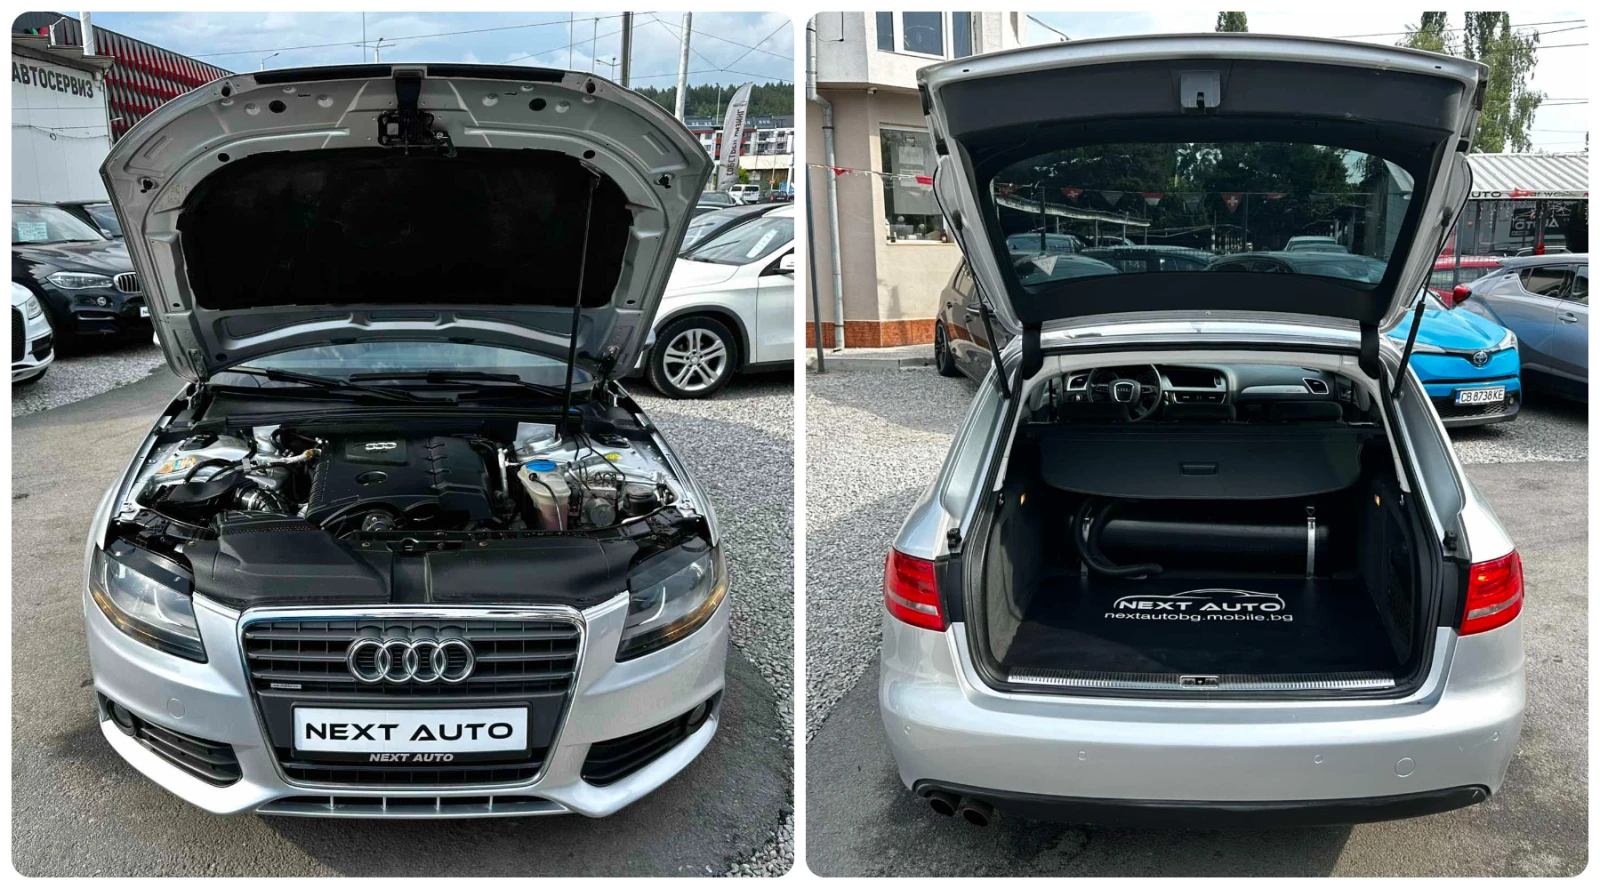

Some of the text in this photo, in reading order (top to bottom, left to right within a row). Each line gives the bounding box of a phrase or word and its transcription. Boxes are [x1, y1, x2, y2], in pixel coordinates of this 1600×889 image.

[12, 61, 94, 98] АВТОСЕРВИЗ
[1119, 601, 1282, 612] NEXT AUTO
[1104, 612, 1293, 622] nextautobg.mobile.bg
[305, 722, 514, 741] NEXT AUTO
[369, 753, 454, 762] NEXT AUTO
